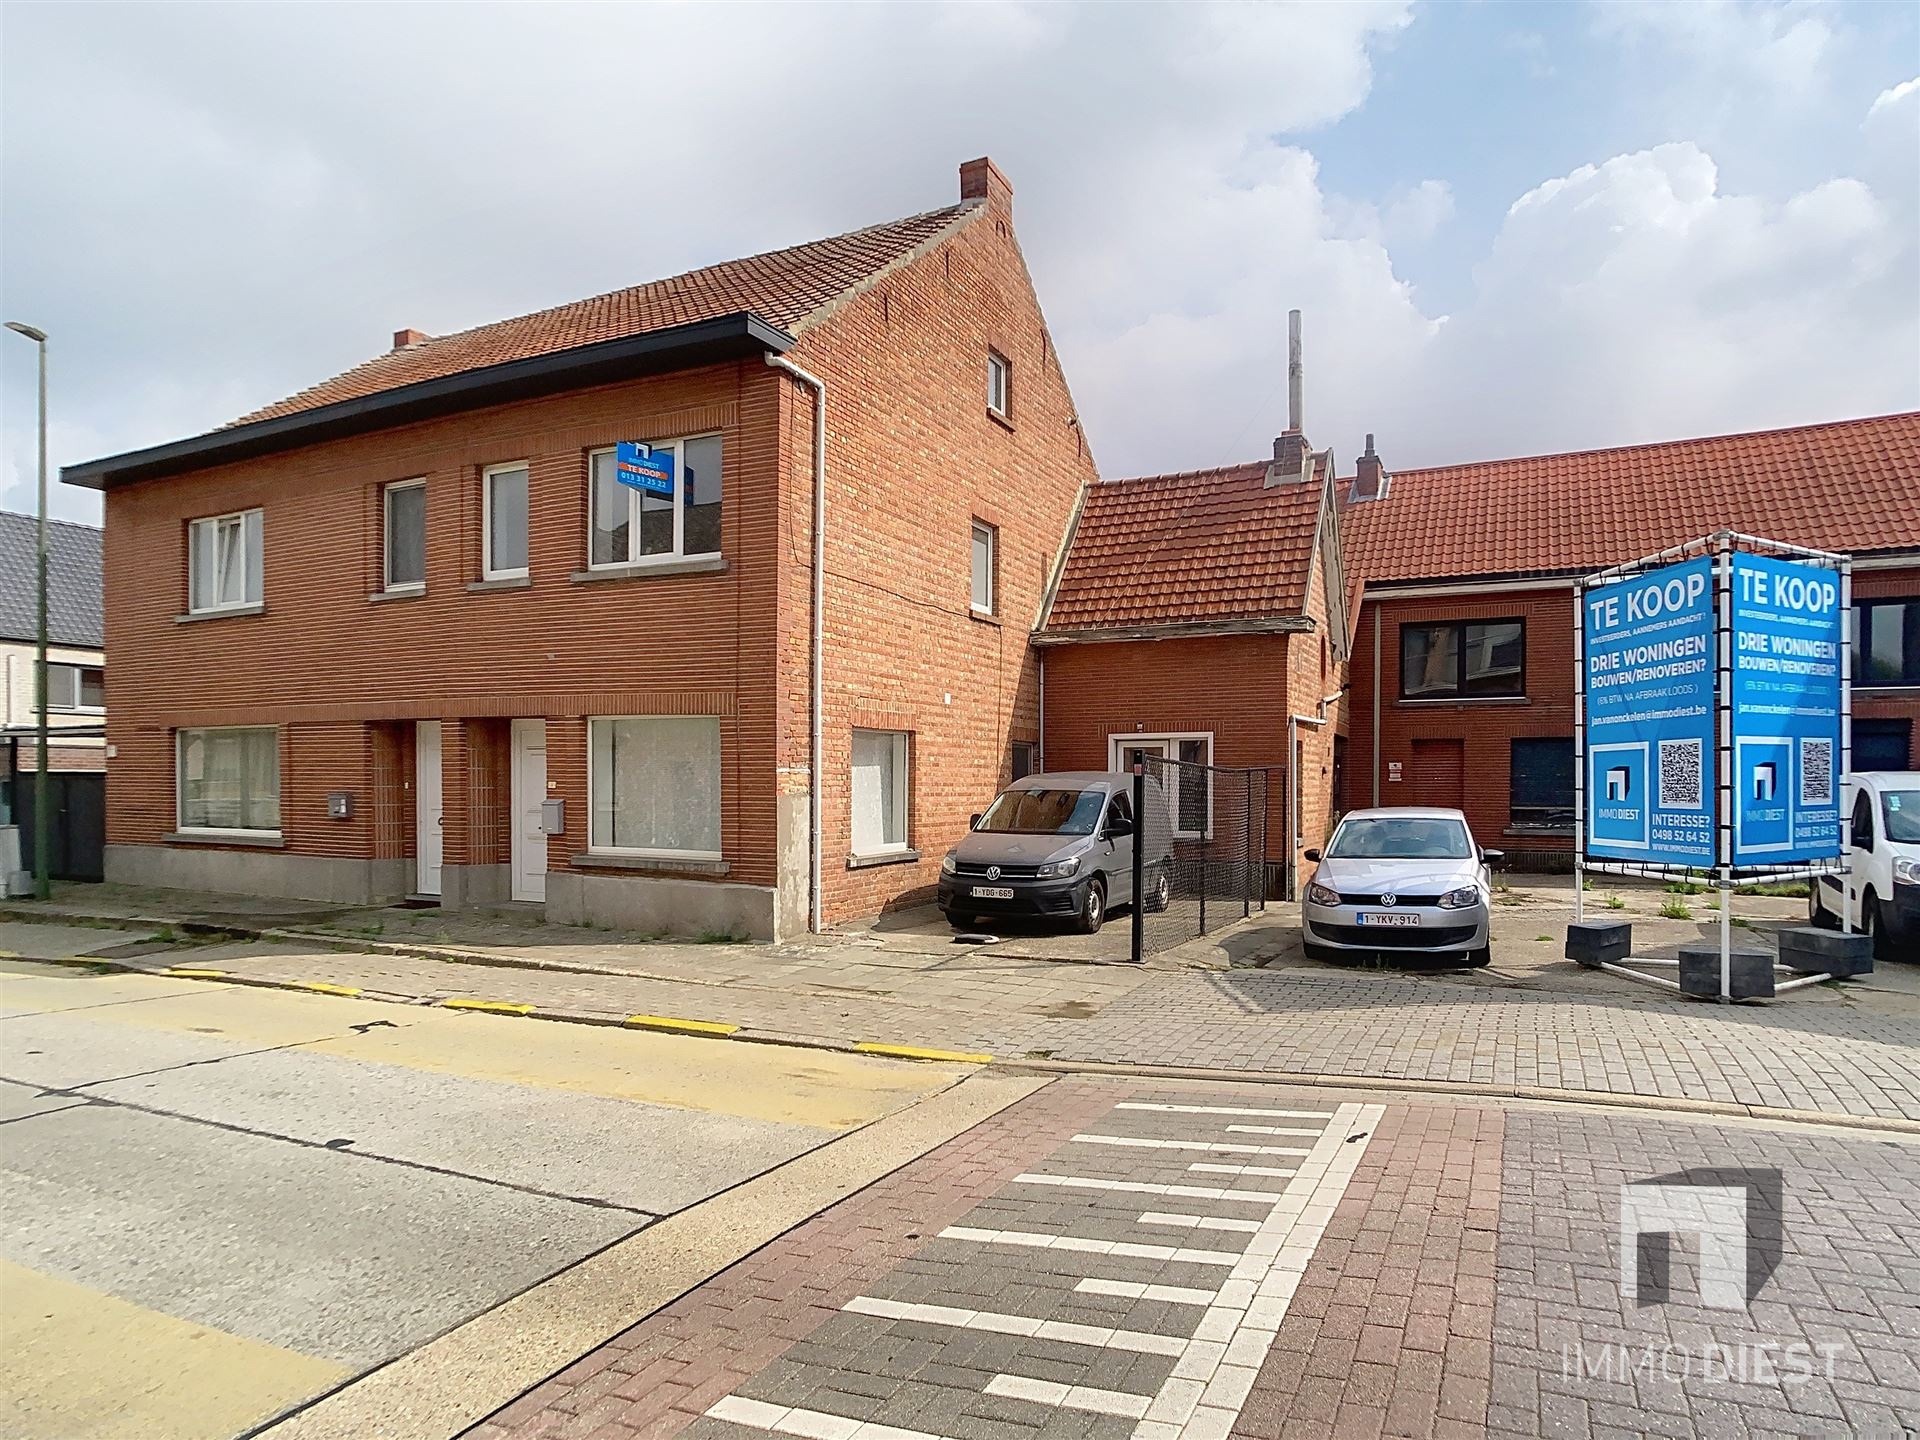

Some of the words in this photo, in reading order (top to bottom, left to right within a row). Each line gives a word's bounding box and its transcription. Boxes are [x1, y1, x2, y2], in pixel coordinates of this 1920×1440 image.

[621, 472, 635, 481] 013
[627, 464, 639, 474] TE
[639, 466, 661, 478] KOOP
[1738, 568, 1768, 605] TE
[1774, 574, 1836, 614] KOOP
[1590, 596, 1619, 630] TE
[1627, 573, 1705, 622] KOOP
[1738, 632, 1768, 652] DRIE
[1770, 635, 1836, 660] WONINGEN
[1590, 652, 1620, 673] DRIE
[1623, 634, 1706, 667] WONINGEN
[1591, 659, 1707, 689] BOUWEN/RENOVEREN?
[1624, 693, 1634, 702] NA
[1635, 689, 1668, 701] AFBRAAK
[1652, 814, 1711, 828] INTERESSE?
[1652, 829, 1672, 841] 0498
[1674, 830, 1684, 842] 52
[1686, 831, 1698, 842] 64
[1699, 832, 1710, 843] 52
[1365, 915, 1418, 925] 1-YKV-914
